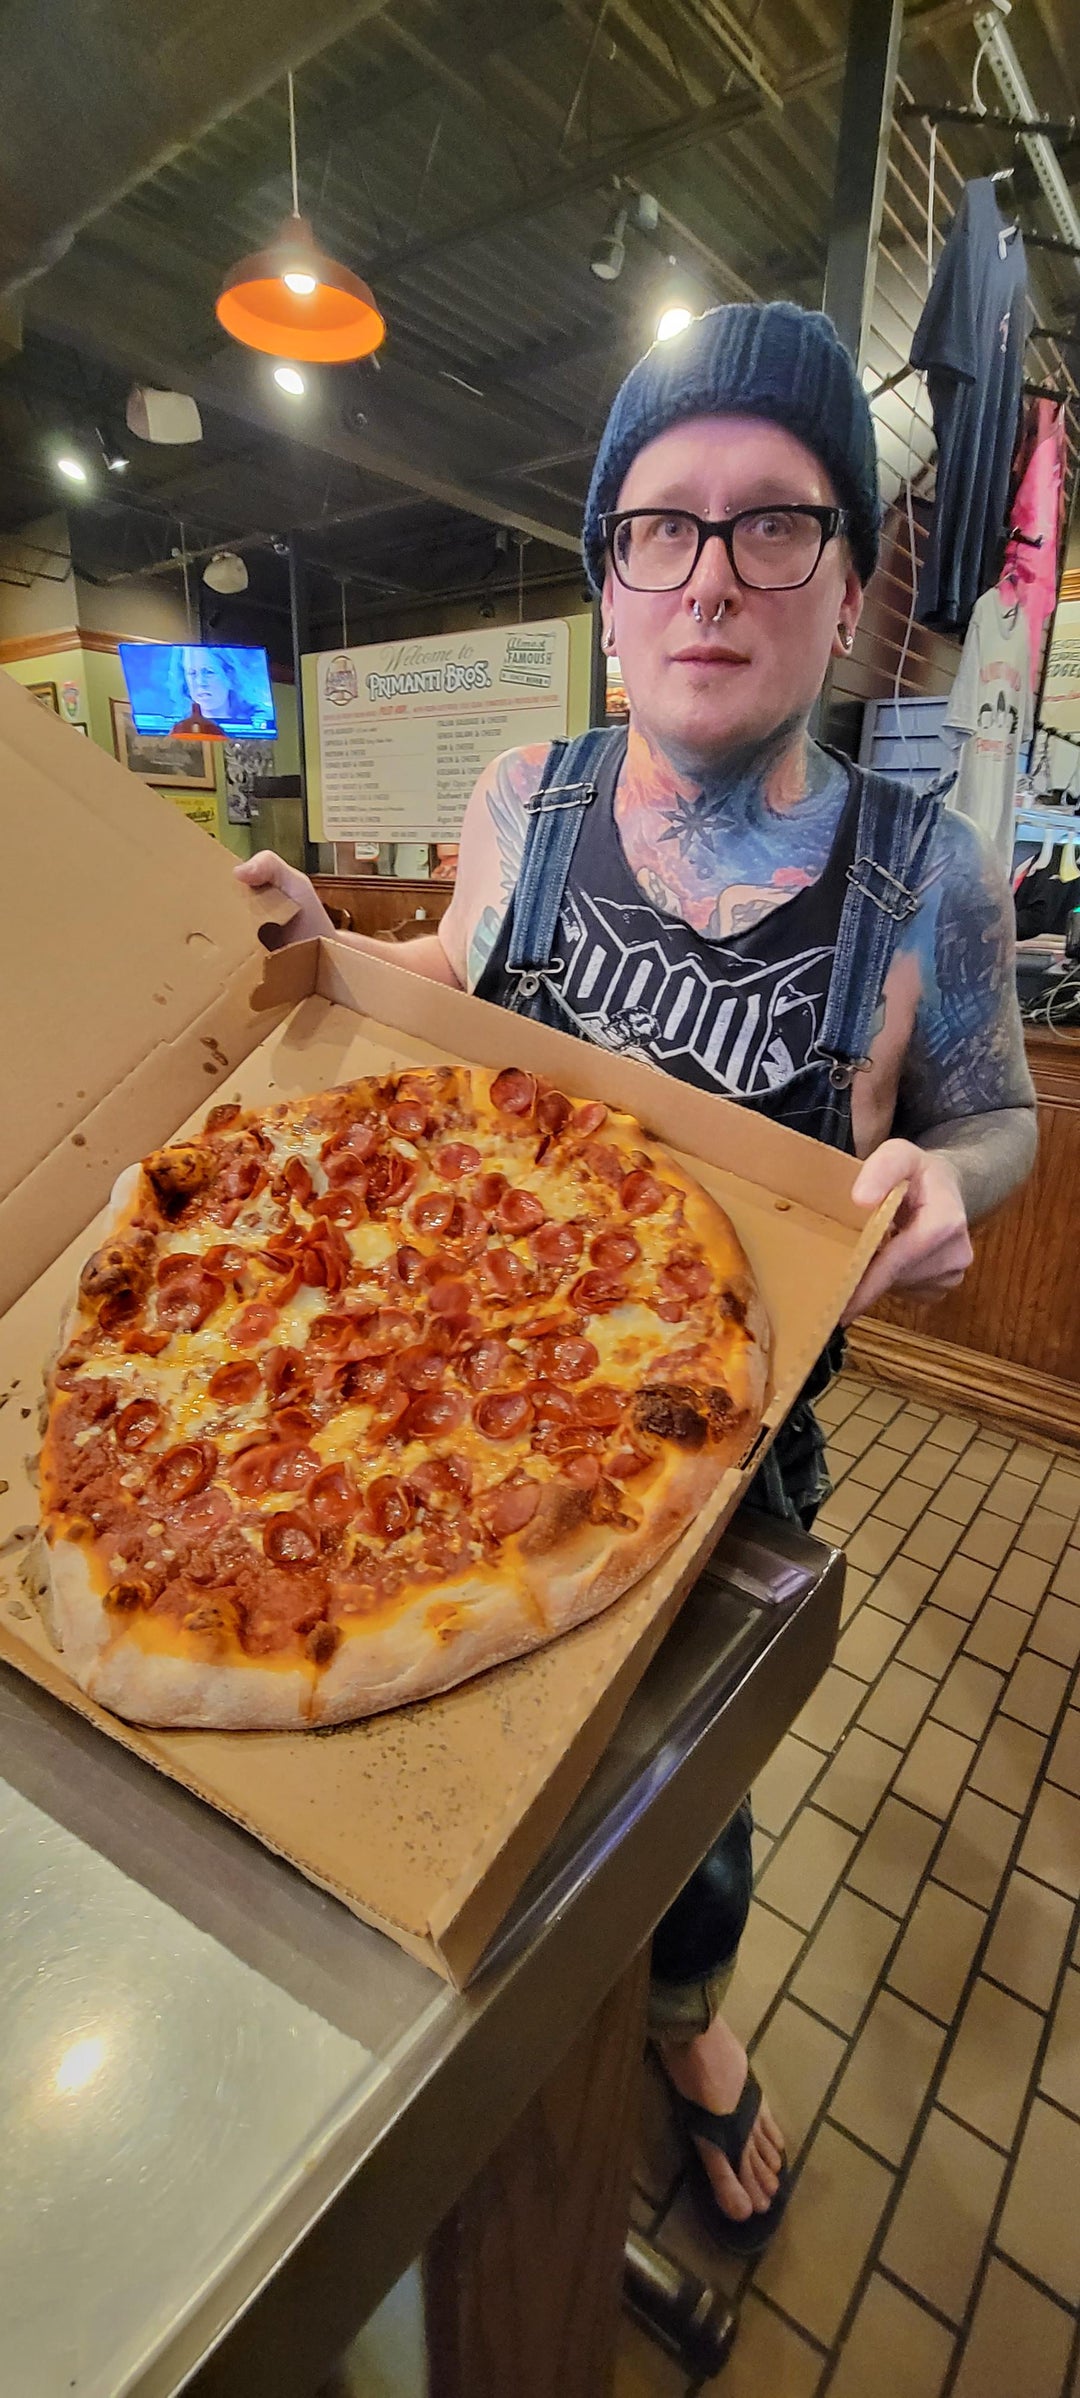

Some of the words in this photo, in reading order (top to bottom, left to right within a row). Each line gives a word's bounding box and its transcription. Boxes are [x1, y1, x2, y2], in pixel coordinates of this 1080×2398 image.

[381, 645, 453, 671] Welcome
[458, 644, 474, 659] to
[507, 652, 545, 665] FAMOUS
[367, 670, 442, 701] PRIMANTI
[444, 660, 492, 693] BROS.
